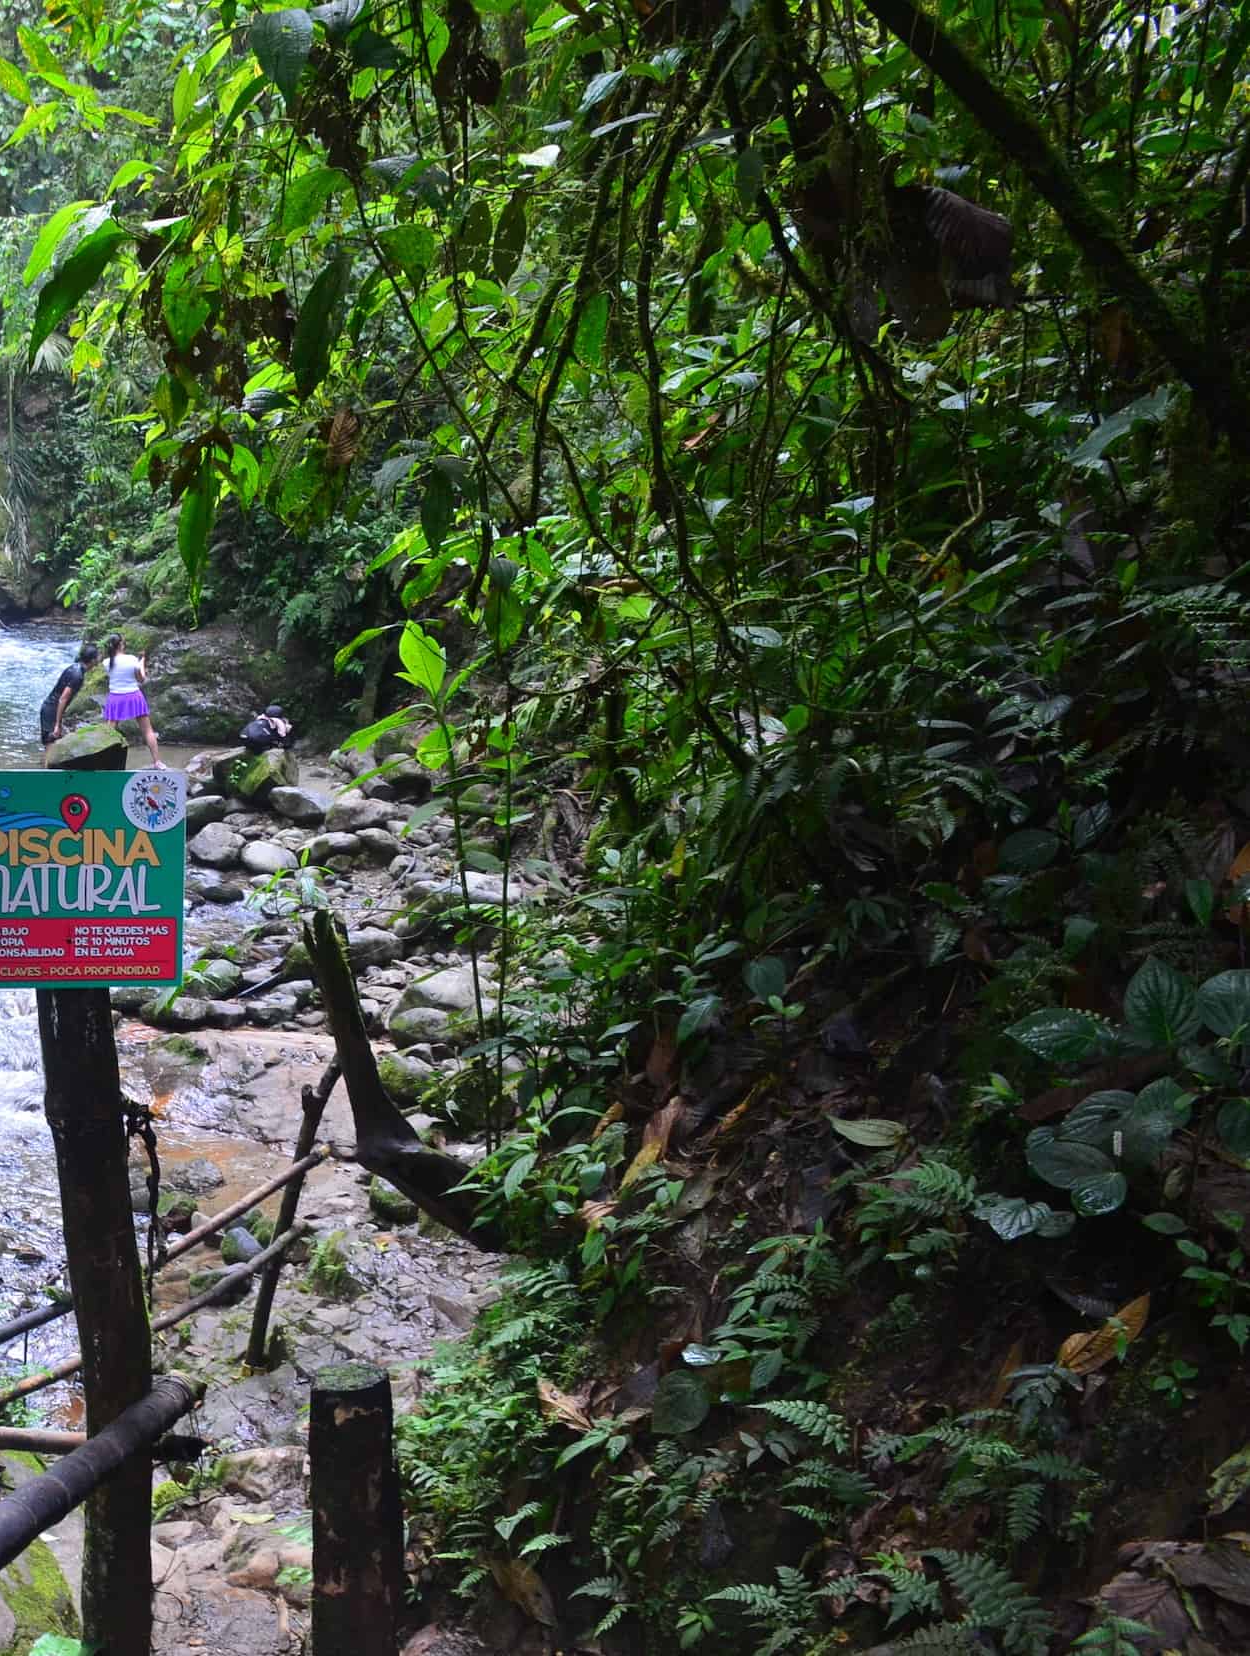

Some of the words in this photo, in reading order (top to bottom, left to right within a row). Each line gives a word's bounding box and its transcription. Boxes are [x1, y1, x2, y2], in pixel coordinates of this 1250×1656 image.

[2, 927, 29, 936] BAJO
[74, 926, 88, 935] NO
[91, 926, 104, 935] TE
[104, 926, 144, 936] QUEDES
[145, 925, 168, 935] MÁS
[74, 937, 88, 946] DE
[92, 937, 102, 946] 10
[104, 937, 150, 946] MINUTOS
[74, 948, 89, 956] EN
[90, 948, 103, 956] EL
[106, 948, 134, 956] AGUA
[0, 966, 41, 976] CLAVES
[50, 966, 82, 976] POCA
[84, 966, 160, 976] PROFUNDIDAD
